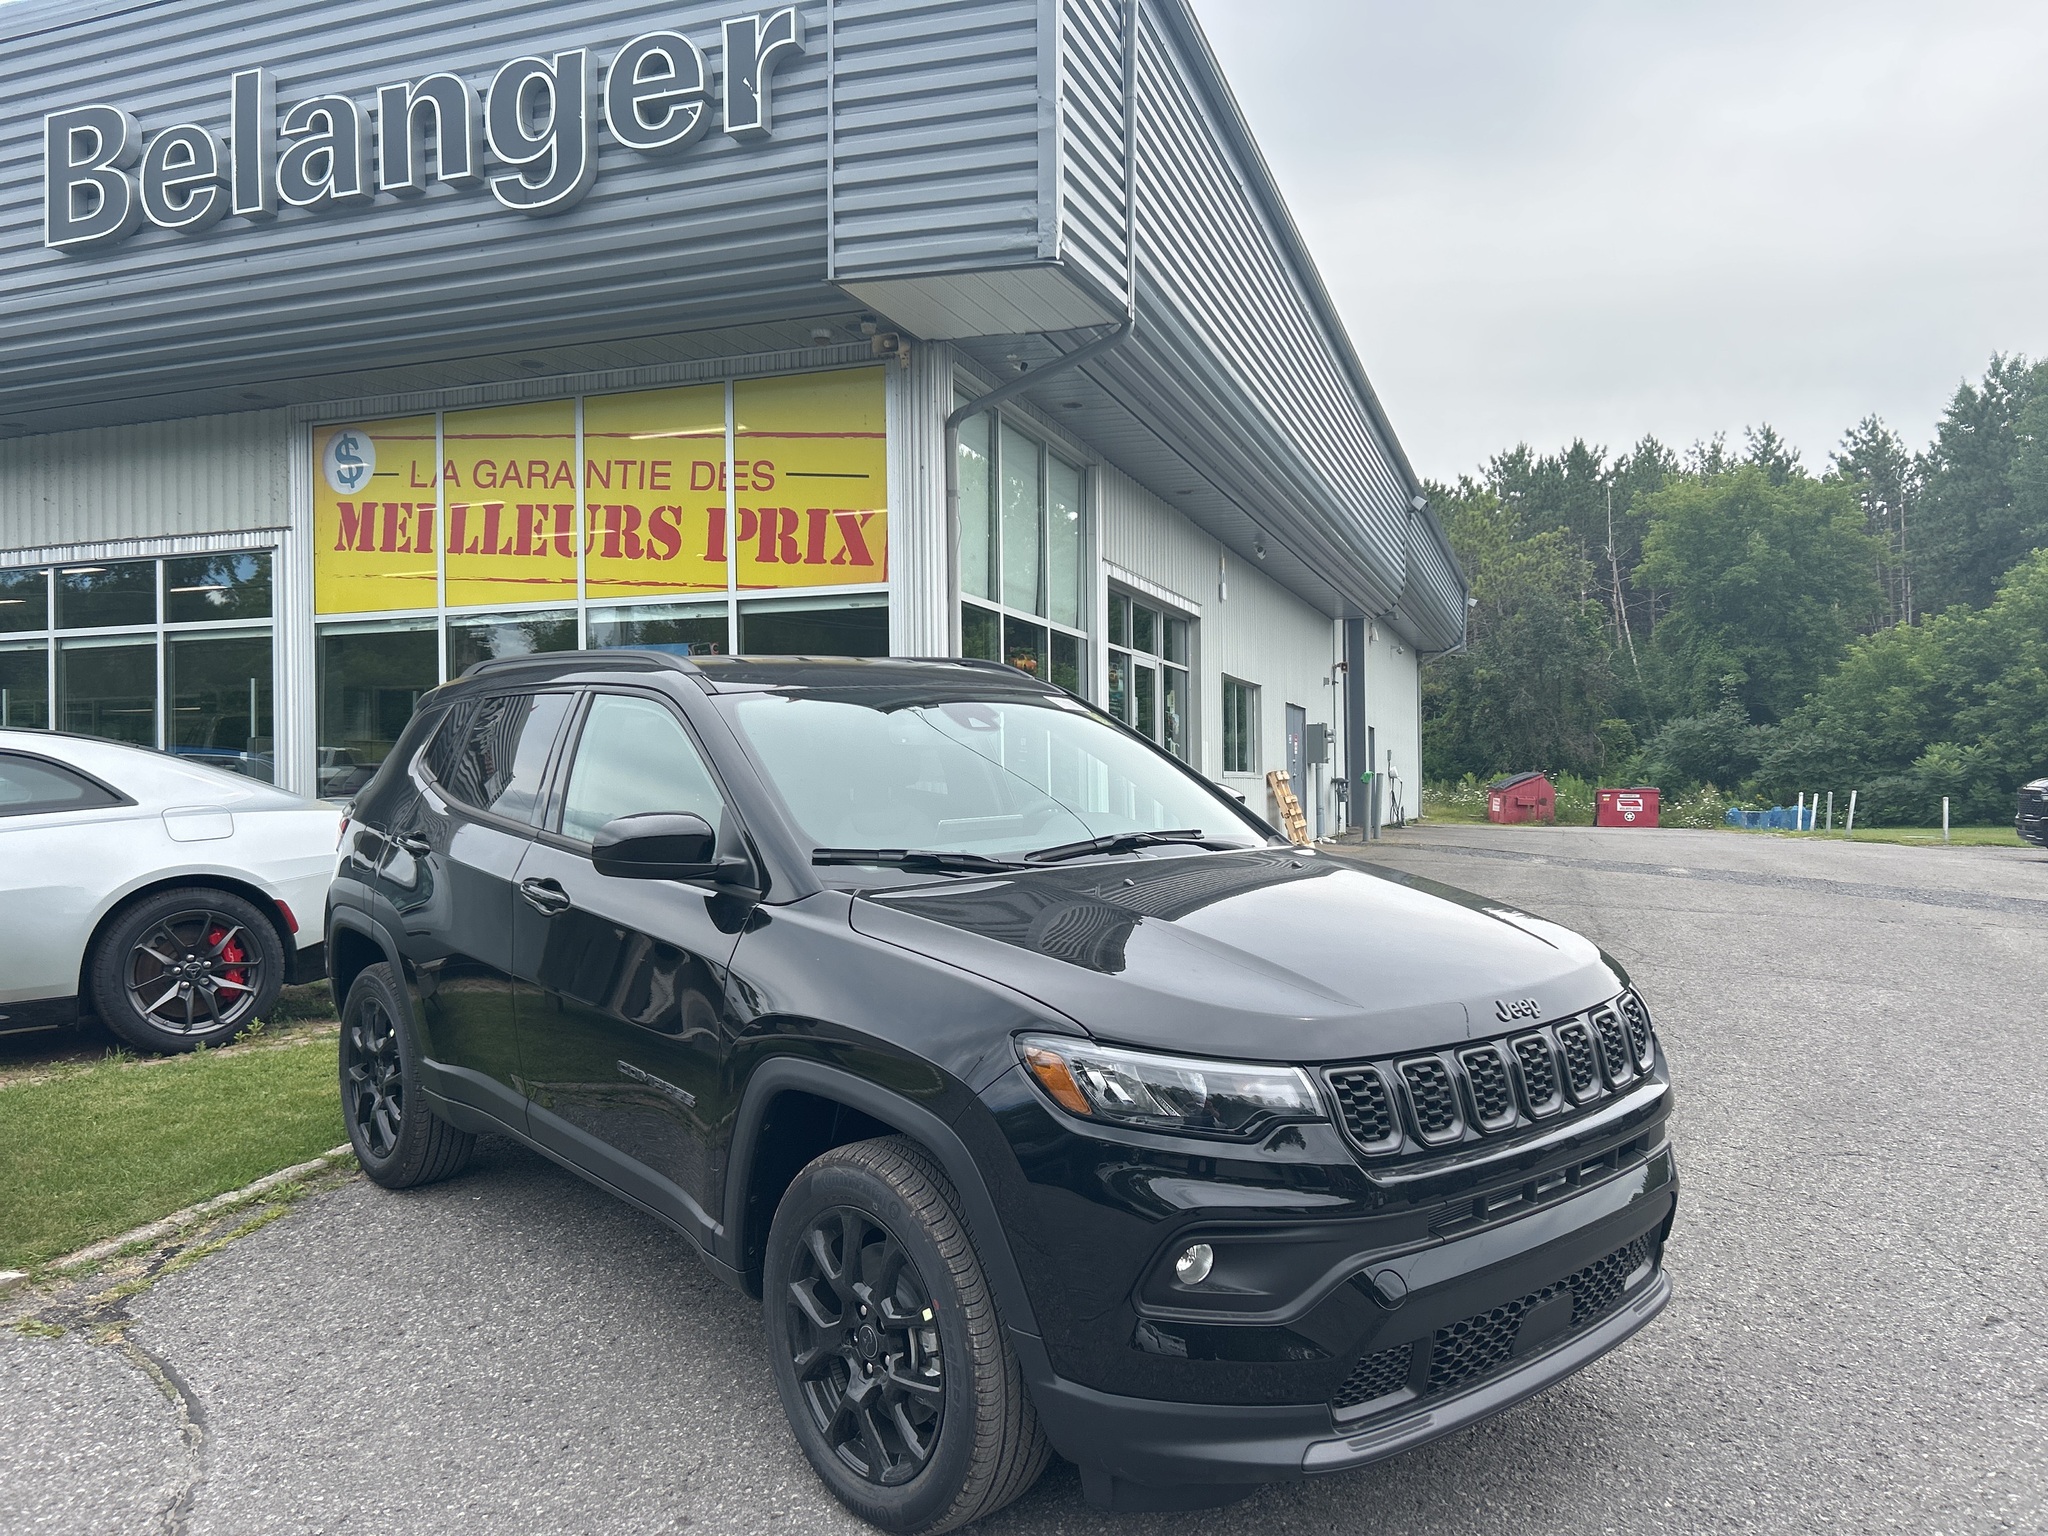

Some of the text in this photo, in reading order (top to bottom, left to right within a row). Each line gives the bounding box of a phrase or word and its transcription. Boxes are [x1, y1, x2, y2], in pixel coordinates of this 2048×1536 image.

[44, 6, 806, 252] Belanger
[410, 459, 775, 491] LA GARANTIE DES
[334, 501, 876, 566] MEILLEURS PRIX
[1495, 997, 1542, 1022] Jeep
